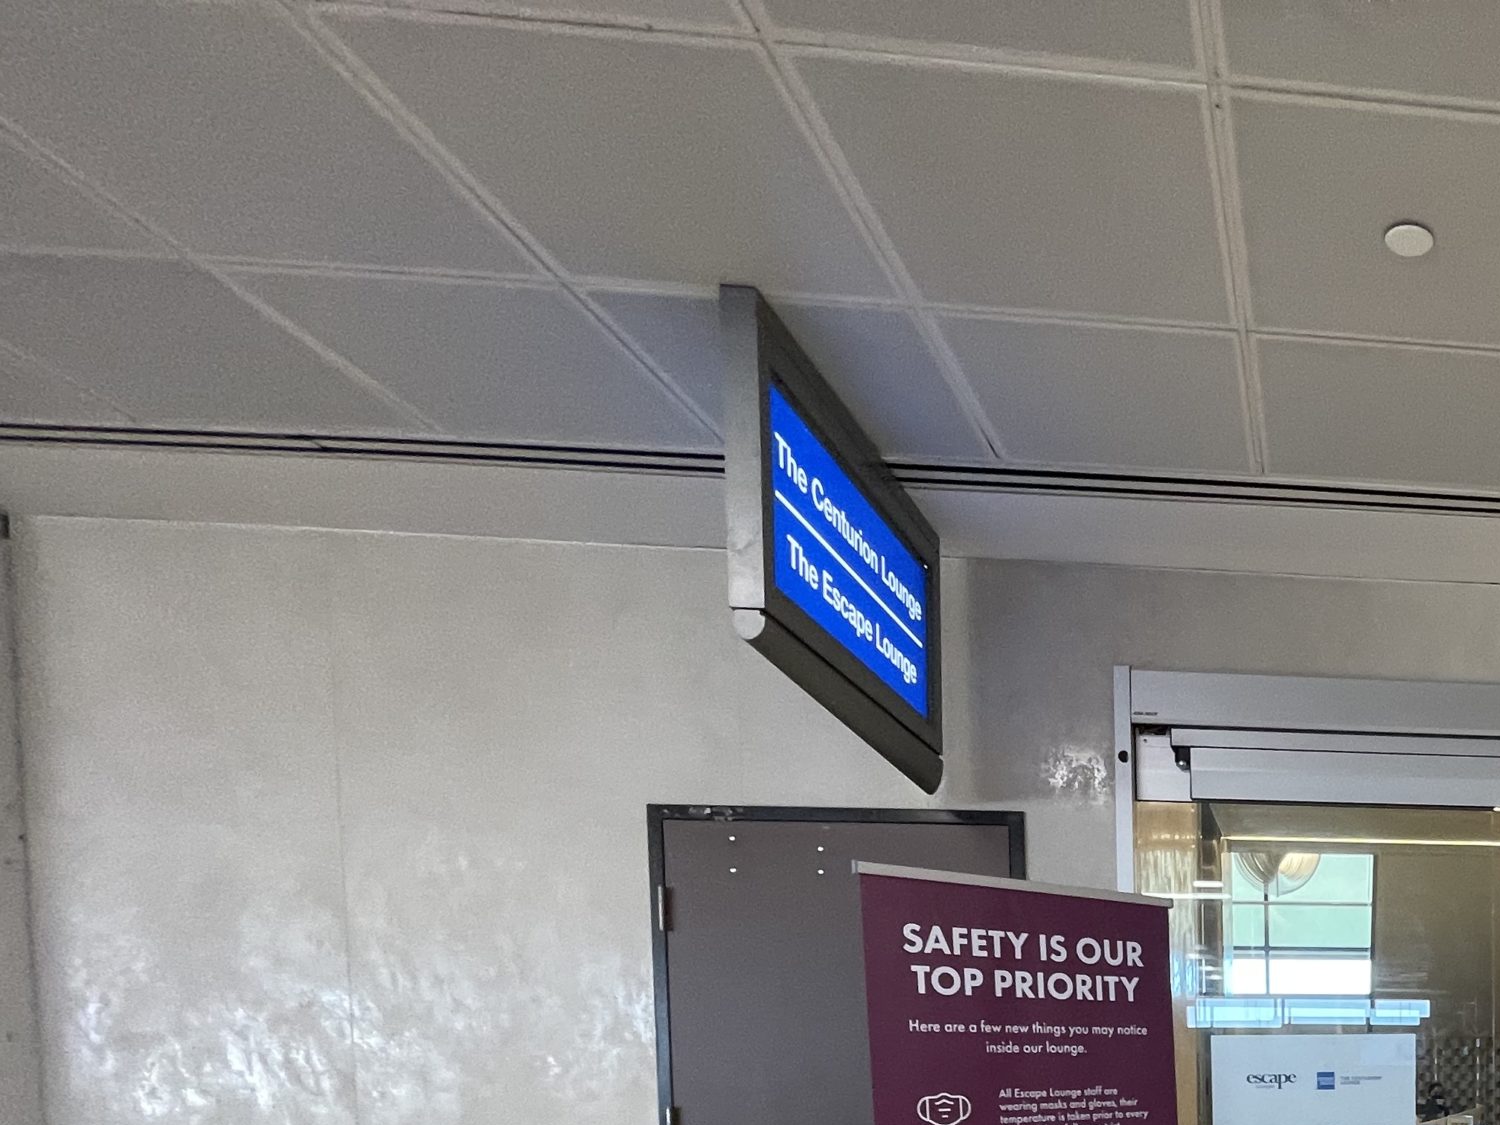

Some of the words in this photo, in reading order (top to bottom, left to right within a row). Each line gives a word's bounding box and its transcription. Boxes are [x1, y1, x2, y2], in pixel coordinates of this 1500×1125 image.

[774, 432, 807, 494] The
[811, 478, 878, 574] Centurion
[881, 556, 922, 621] Lounge
[787, 534, 818, 590] The
[823, 570, 873, 641] Escape
[876, 623, 917, 684] Lounge
[903, 923, 1029, 959] SAFETY
[1039, 934, 1067, 962] IS
[1076, 938, 1144, 967] OUR
[911, 965, 983, 996] TOP
[994, 970, 1139, 1001] PRIORITY
[909, 1020, 940, 1033] Here
[945, 1023, 965, 1033] are
[969, 1024, 977, 1033] a
[980, 1020, 1001, 1033] few
[1005, 1025, 1028, 1033] new
[1033, 1022, 1066, 1036] things
[1069, 1026, 1088, 1037] you
[1092, 1026, 1114, 1037] may
[1118, 1024, 1147, 1035] notice
[986, 1042, 1019, 1053] inside
[1023, 1044, 1042, 1053] our
[1046, 1041, 1087, 1056] lounge.
[1247, 1074, 1297, 1089] escape
[999, 1089, 1011, 1098] All
[1015, 1088, 1047, 1099] Escape
[1050, 1088, 1081, 1099] Lounge
[1084, 1086, 1102, 1095] staff
[999, 1101, 1037, 1112] wearing
[1040, 1100, 1067, 1109] masks
[1069, 1099, 1086, 1108] and
[1119, 1097, 1138, 1106] their
[1000, 1114, 1055, 1124] temperature
[1058, 1112, 1065, 1121] is
[1067, 1111, 1090, 1121] taken
[1093, 1111, 1112, 1121] prior
[1126, 1111, 1149, 1119] every
